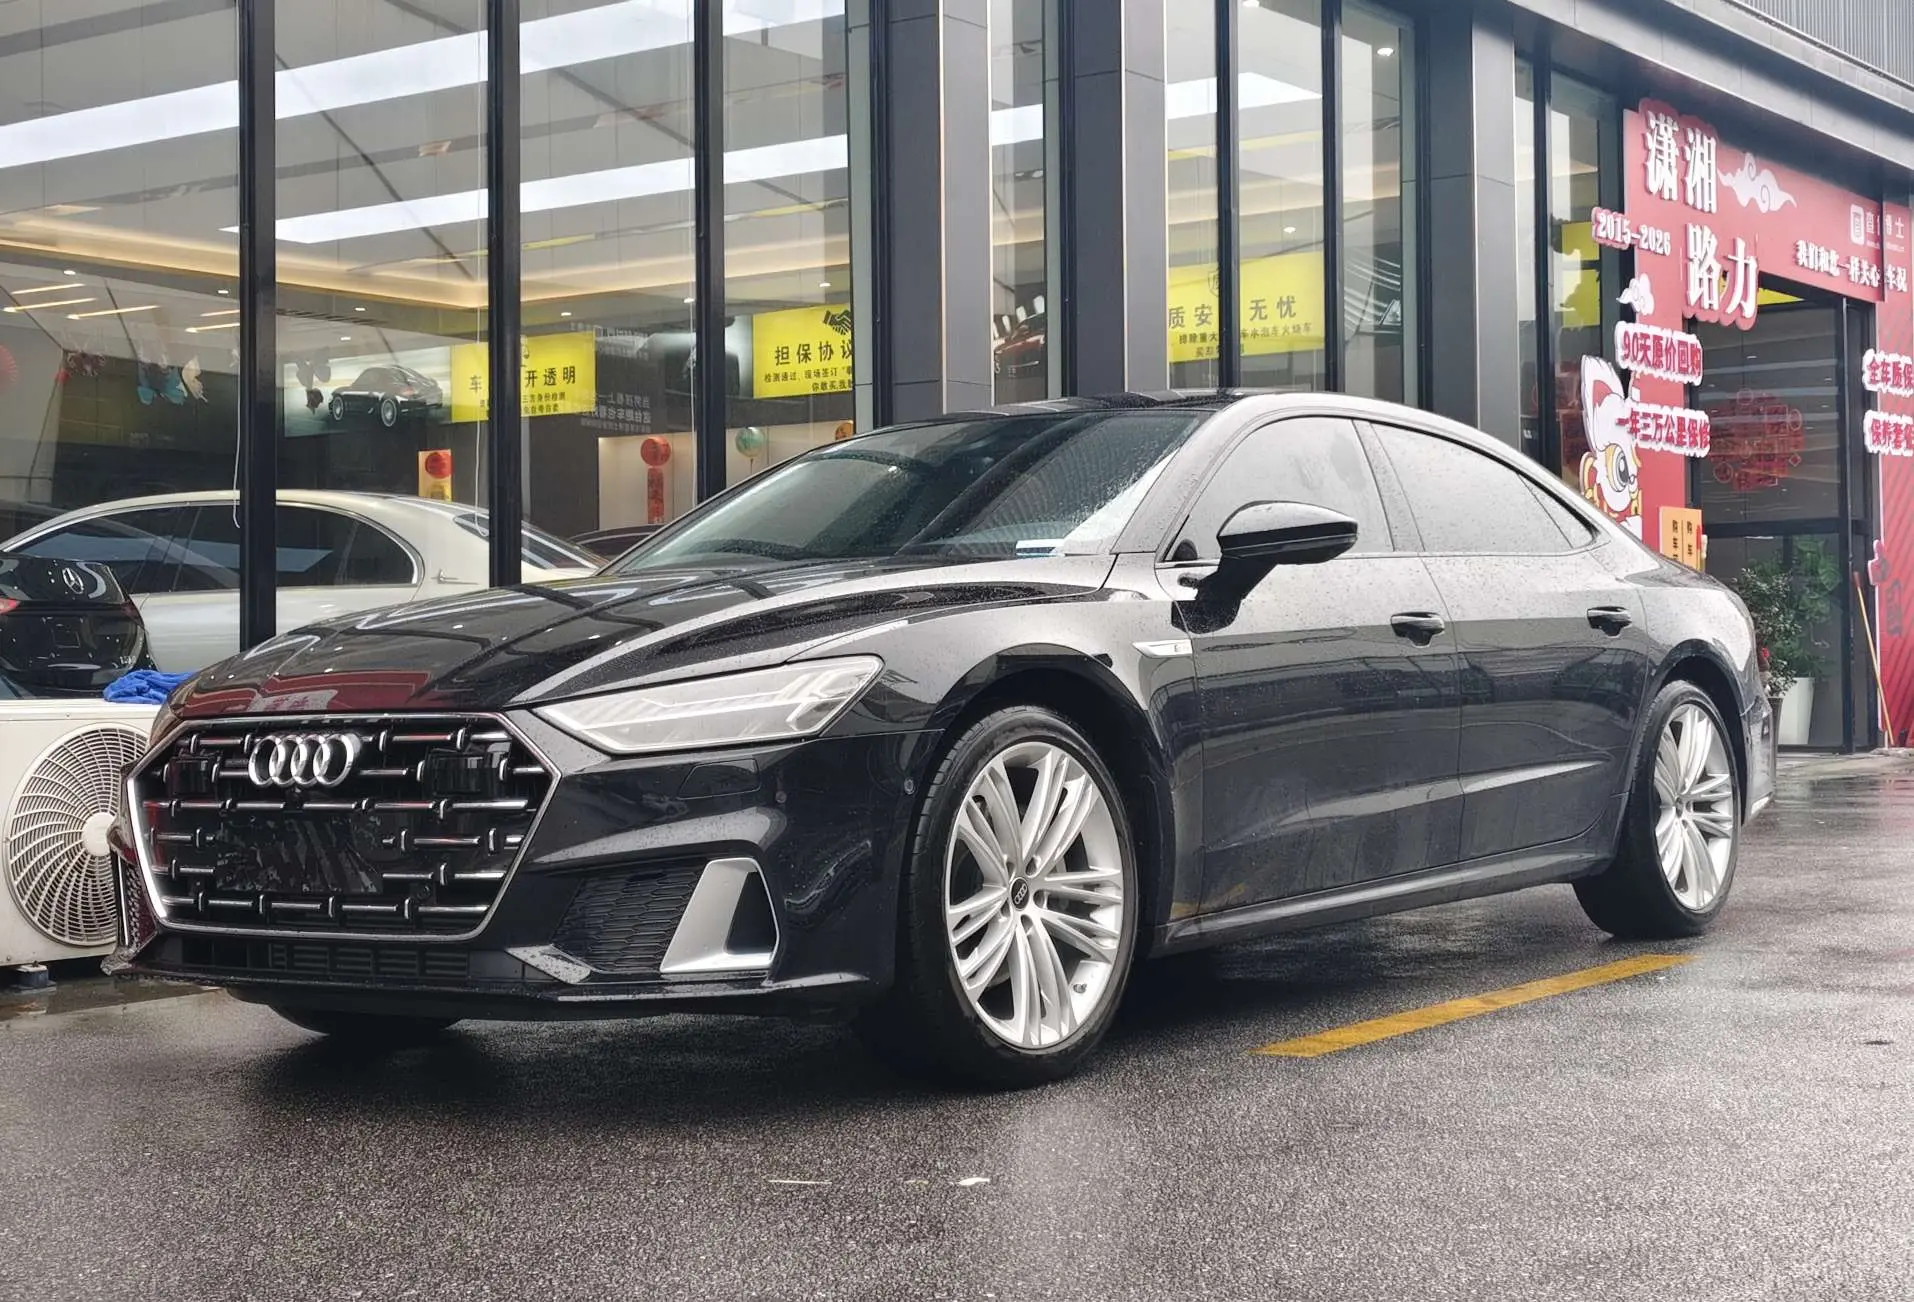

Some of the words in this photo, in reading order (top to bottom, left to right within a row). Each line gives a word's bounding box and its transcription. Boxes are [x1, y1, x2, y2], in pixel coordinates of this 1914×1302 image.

[1645, 111, 1717, 213] 潇湘
[1597, 212, 1671, 257] 2015-2026
[1686, 222, 1758, 318] 路力
